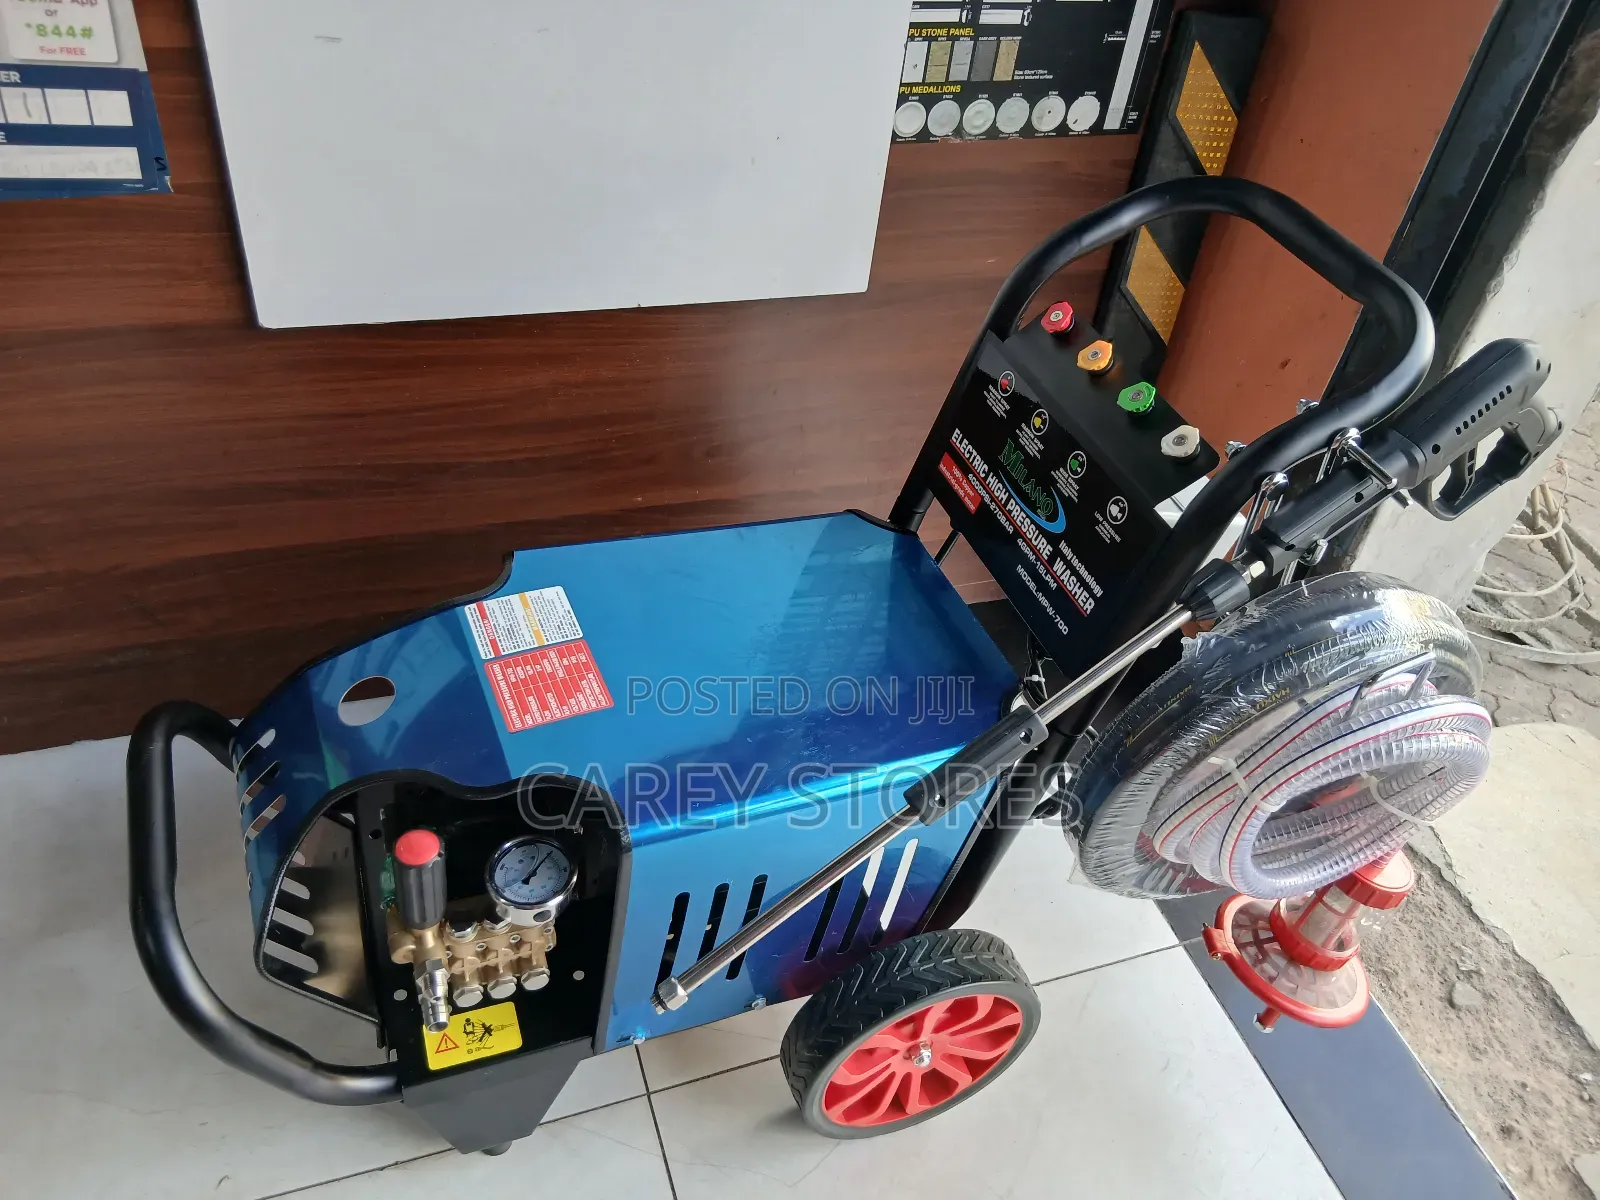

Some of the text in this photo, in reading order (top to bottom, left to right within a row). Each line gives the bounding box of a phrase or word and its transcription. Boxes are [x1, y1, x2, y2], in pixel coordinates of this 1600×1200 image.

[44, 9, 58, 17] or
[909, 28, 975, 36] PU STONE PANEL
[39, 46, 86, 56] For FREE
[0, 71, 21, 83] ER
[900, 85, 961, 94] PU MEDALLIONS
[952, 465, 963, 481] 100%
[951, 427, 989, 478] ELECTRIC
[986, 472, 1009, 505] HIGH
[1006, 498, 1053, 561] PRESSURE
[1053, 557, 1095, 615] WASHER
[1094, 510, 1122, 543] LOW PRESSURE
[967, 473, 1014, 535] 4000PSI-270BAR
[1016, 538, 1058, 591] 4GPM-15LPM
[1058, 539, 1104, 598] Italy technology
[1016, 564, 1069, 635] MODEL:MPW-700
[482, 617, 495, 639] DANGER!
